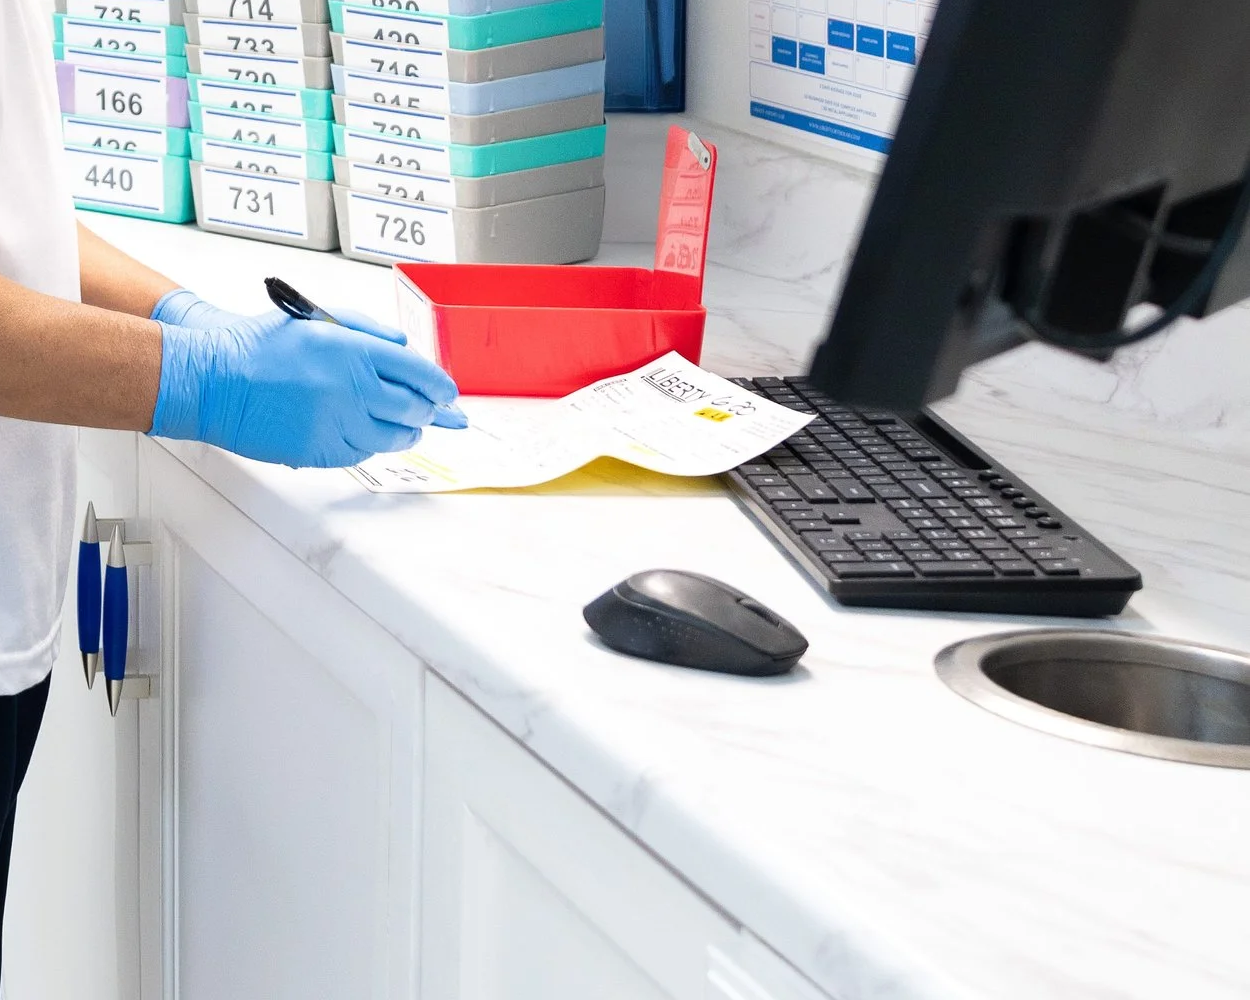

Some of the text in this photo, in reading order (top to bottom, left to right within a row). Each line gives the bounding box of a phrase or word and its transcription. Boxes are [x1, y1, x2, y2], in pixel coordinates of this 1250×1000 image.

[96, 88, 143, 115] 166
[84, 165, 134, 192] 440
[229, 186, 274, 216] 731
[375, 213, 426, 246] 726
[645, 368, 712, 404] LIBERTY
